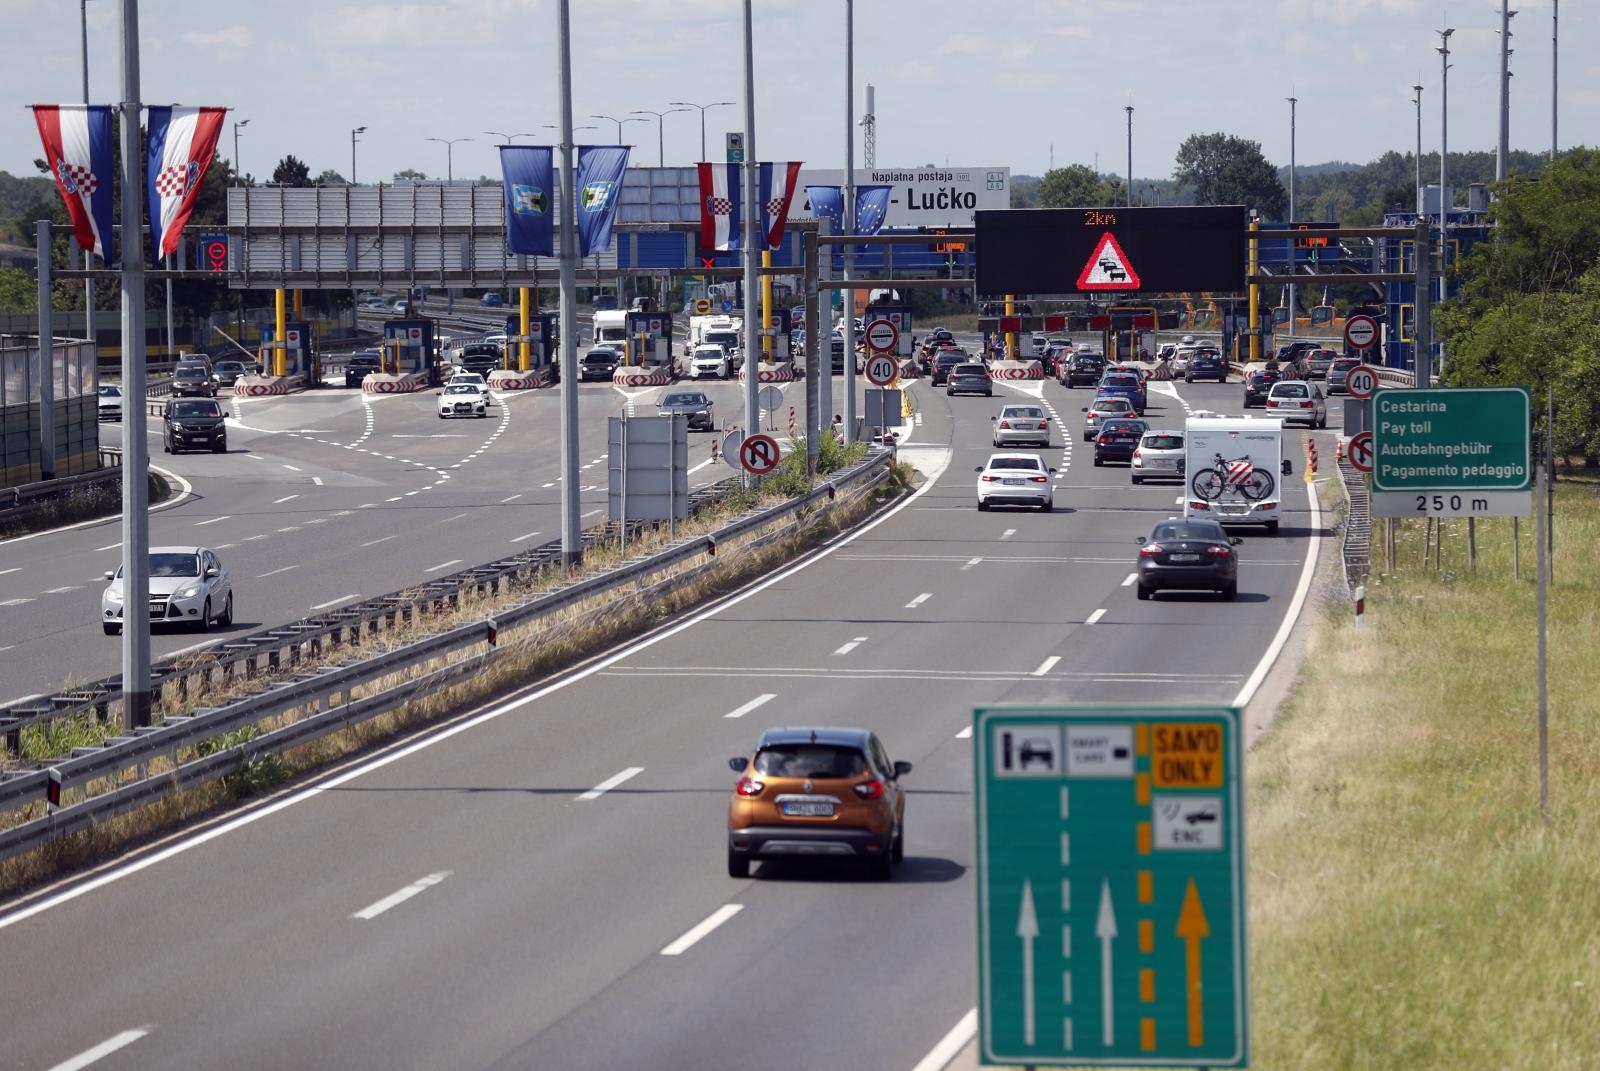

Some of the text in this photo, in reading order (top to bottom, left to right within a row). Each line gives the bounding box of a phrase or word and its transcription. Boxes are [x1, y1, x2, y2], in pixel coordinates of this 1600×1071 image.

[872, 172, 914, 184] Naplatna
[918, 171, 953, 183] postaja
[907, 187, 977, 210] Lučko
[1084, 211, 1116, 225] 2km
[873, 362, 891, 377] 40
[1353, 375, 1371, 390] 40
[1381, 400, 1447, 413] Cestarina
[1381, 421, 1432, 436] Pay toll
[1381, 442, 1493, 457] Autobahngebühr
[1382, 463, 1524, 479] Pagamento pedaggio
[1416, 495, 1488, 511] 250 m
[1156, 729, 1219, 752] SAMO
[1160, 759, 1214, 783] ONLY
[1172, 831, 1203, 844] ENC
